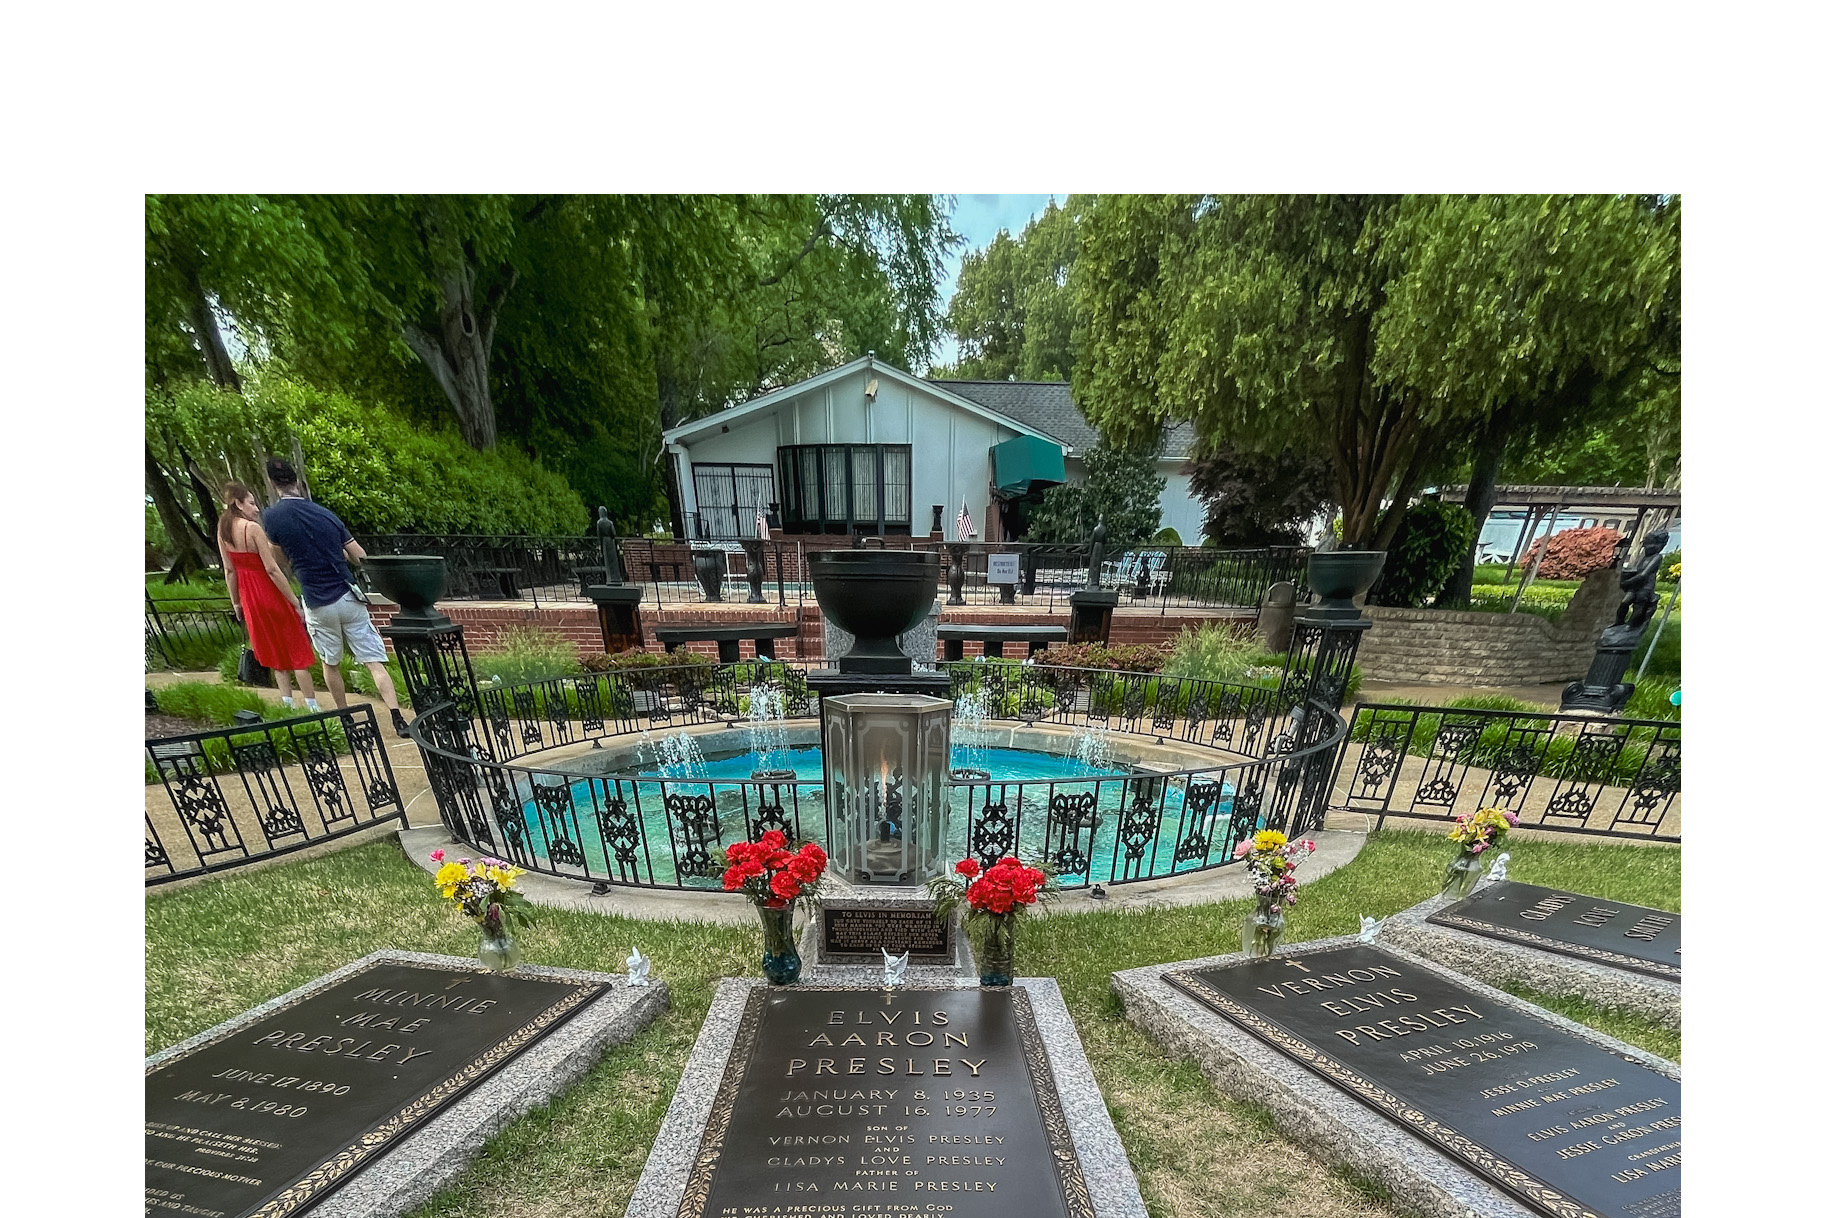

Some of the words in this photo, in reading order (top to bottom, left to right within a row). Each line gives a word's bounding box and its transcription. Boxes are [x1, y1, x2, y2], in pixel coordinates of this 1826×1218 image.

[1519, 893, 1577, 921] GLADYS
[1572, 906, 1620, 928] LOVE
[1623, 914, 1674, 942] SMITH
[1257, 964, 1402, 1000] VERNON
[353, 987, 497, 1016] MINNIE
[1319, 987, 1419, 1018] ELVIS
[340, 1011, 431, 1035] MAE
[827, 1010, 949, 1026] ELVIS
[1334, 1004, 1484, 1047] PRESLEY
[252, 1029, 434, 1066] PRESLEY
[808, 1031, 969, 1048] AARON
[1399, 1044, 1453, 1063] APRIL
[786, 1057, 987, 1077] PRESLEY
[1420, 1056, 1472, 1075] JUNE
[212, 1068, 275, 1084] JUNE
[173, 1090, 231, 1105] MAY
[780, 1089, 899, 1101] JANUARY
[943, 1089, 996, 1102] 1935
[1479, 1083, 1519, 1099] JESSE
[1491, 1098, 1542, 1118] MINNIE
[1540, 1091, 1572, 1105] MAE
[1568, 1077, 1621, 1097] PRESLEY
[776, 1104, 888, 1118] AUGUST
[945, 1105, 997, 1118] 1977
[1527, 1125, 1570, 1142] ELVIS
[1569, 1111, 1618, 1131] AARON
[1614, 1097, 1670, 1117] PRESLEY
[1607, 1121, 1627, 1131] AND
[768, 1134, 851, 1146] VERNON
[864, 1134, 916, 1144] ELVIS
[928, 1134, 1006, 1145] PRESLEY
[1555, 1140, 1603, 1160] JESSIE
[767, 1155, 846, 1167] GLADYS
[860, 1155, 912, 1166] LOVE
[926, 1155, 1006, 1167] PRESLEY
[1610, 1166, 1649, 1184] LISA
[774, 1182, 819, 1192] LISA
[832, 1181, 898, 1192] MARIE
[915, 1181, 998, 1193] PRESLEY
[743, 1206, 768, 1214] WAS
[786, 1205, 846, 1213] PRECIOUS
